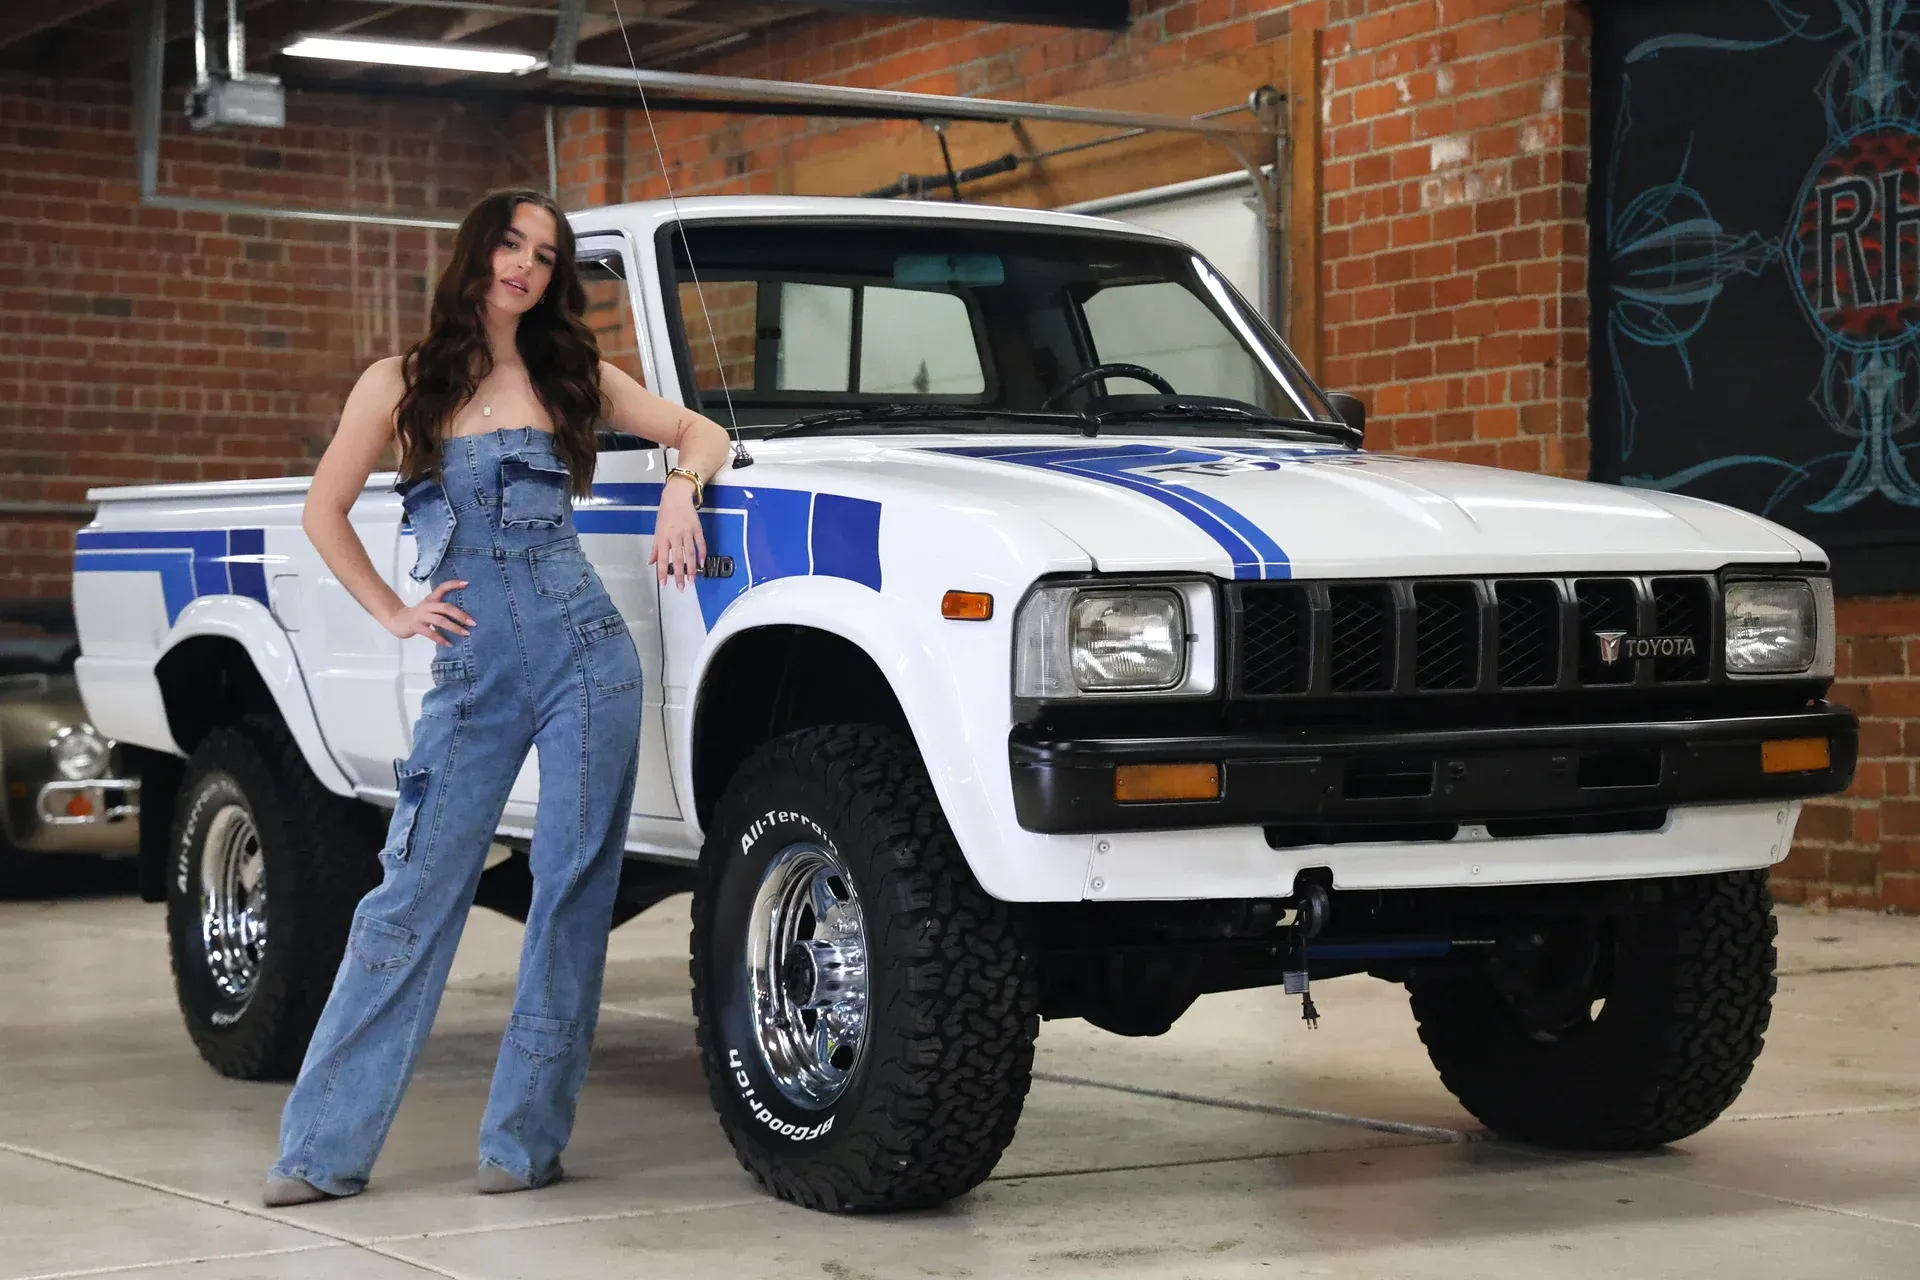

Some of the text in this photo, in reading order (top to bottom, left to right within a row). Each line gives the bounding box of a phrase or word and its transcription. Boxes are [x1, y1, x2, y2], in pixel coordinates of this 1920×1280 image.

[1625, 638, 1696, 657] TOYOTA
[741, 810, 838, 856] All-Terrain
[728, 1048, 836, 1141] BFGoodrich
